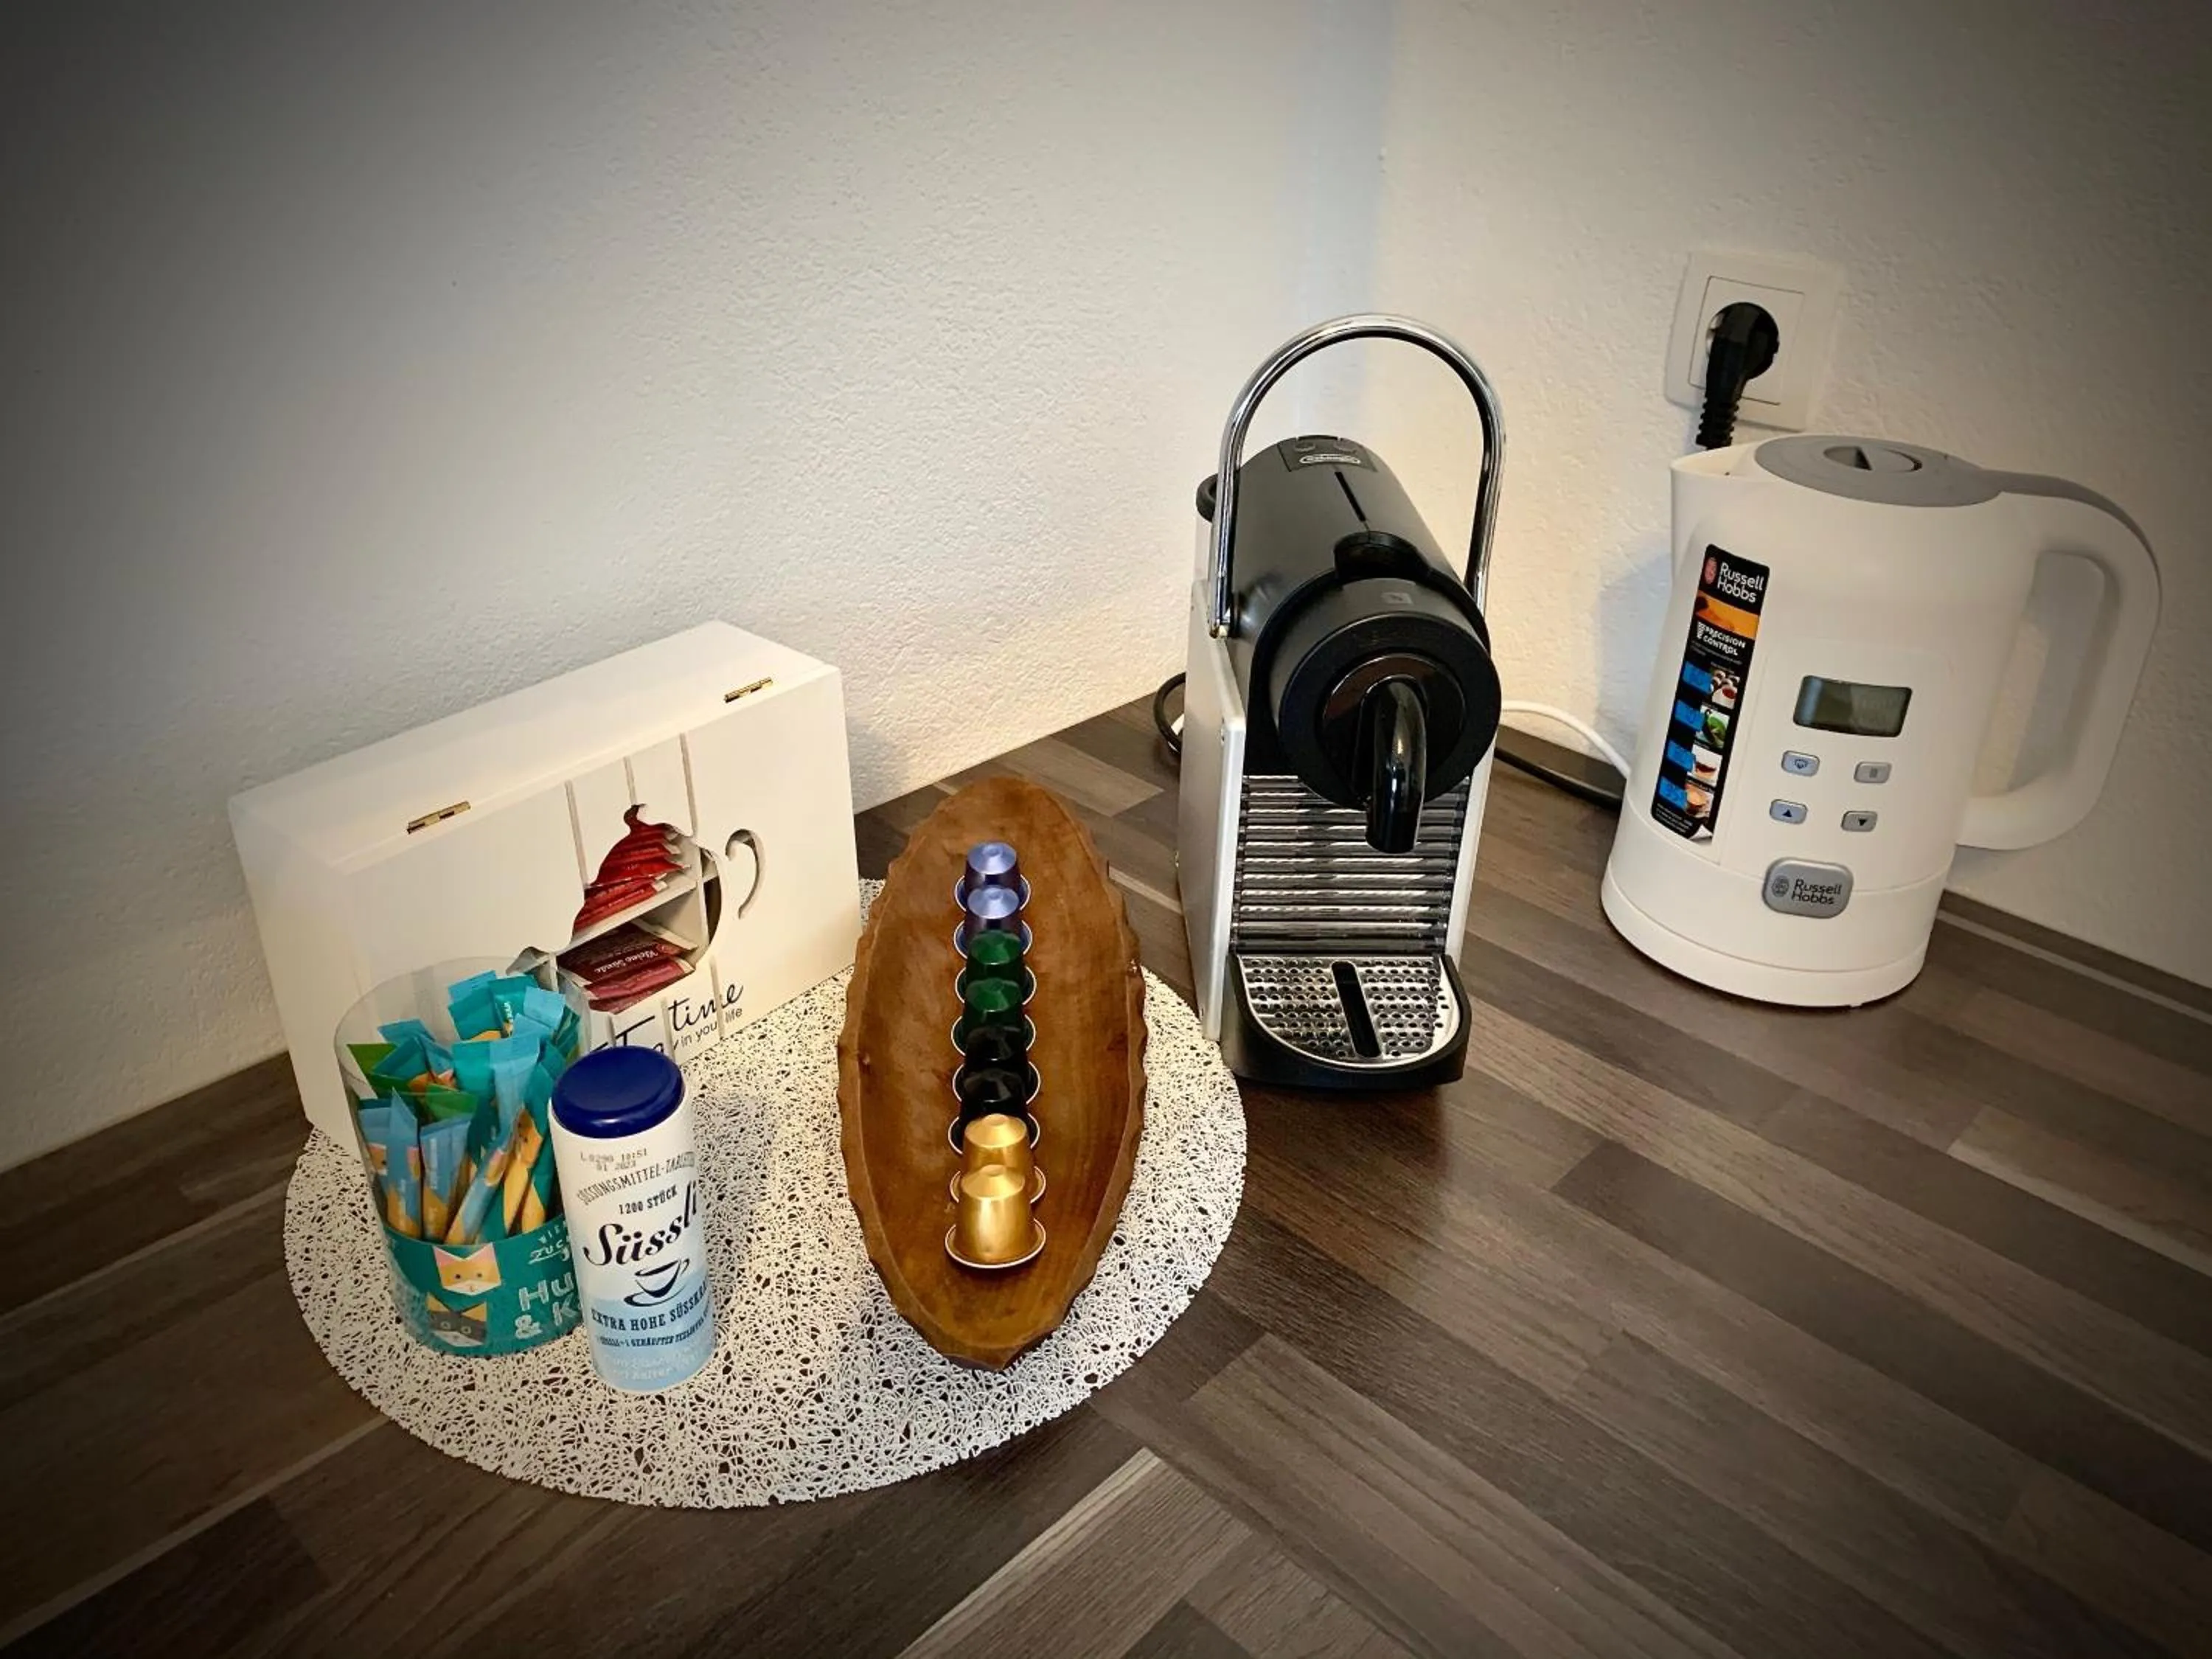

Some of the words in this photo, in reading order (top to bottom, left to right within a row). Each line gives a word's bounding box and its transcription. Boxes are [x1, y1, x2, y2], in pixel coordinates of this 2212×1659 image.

[1717, 576, 1757, 603] Hobbs
[1720, 562, 1764, 591] Russell
[1792, 890, 1835, 905] Hobbs
[1794, 878, 1842, 894] Russell
[695, 1020, 718, 1043] you
[724, 1007, 743, 1023] life
[619, 1201, 644, 1215] 1200
[647, 1184, 678, 1209] STÜCK
[515, 1314, 543, 1339] &
[591, 1309, 626, 1331] EXTRA
[630, 1314, 667, 1331] HOHE
